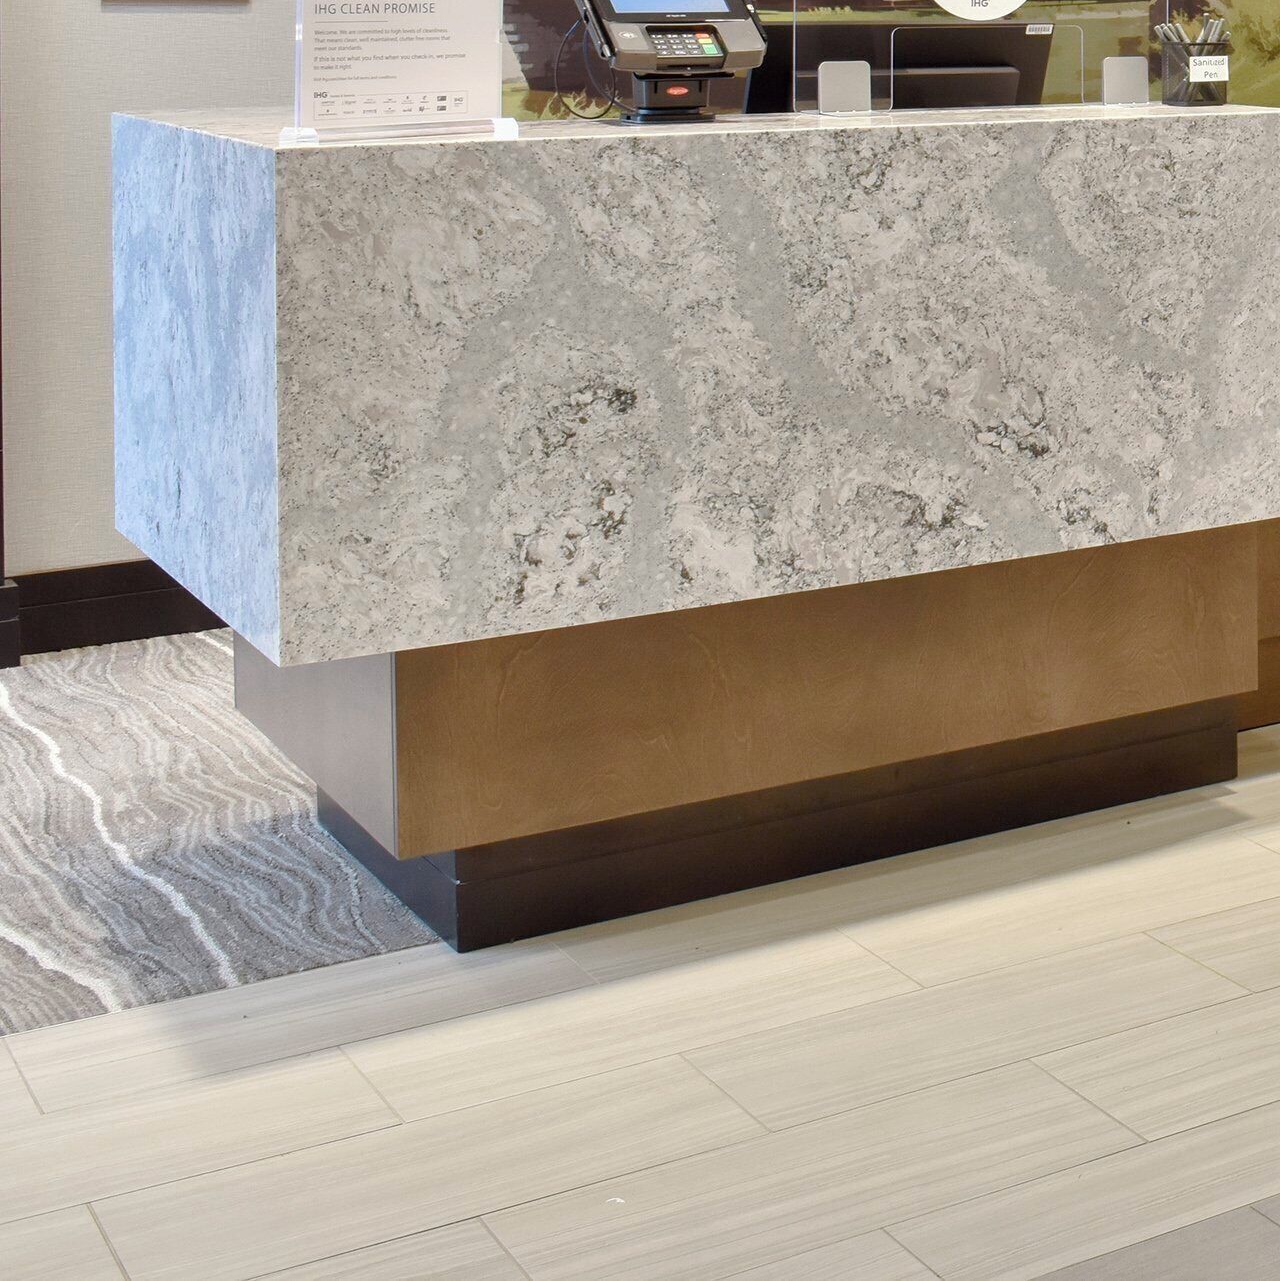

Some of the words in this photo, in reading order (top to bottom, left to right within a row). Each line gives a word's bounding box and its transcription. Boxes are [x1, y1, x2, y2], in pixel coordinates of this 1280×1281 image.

[971, 0, 989, 7] IHG
[315, 3, 336, 15] IHG
[340, 3, 380, 14] CLEAN
[384, 2, 436, 14] PROMISE
[1193, 58, 1224, 67] Sanitized
